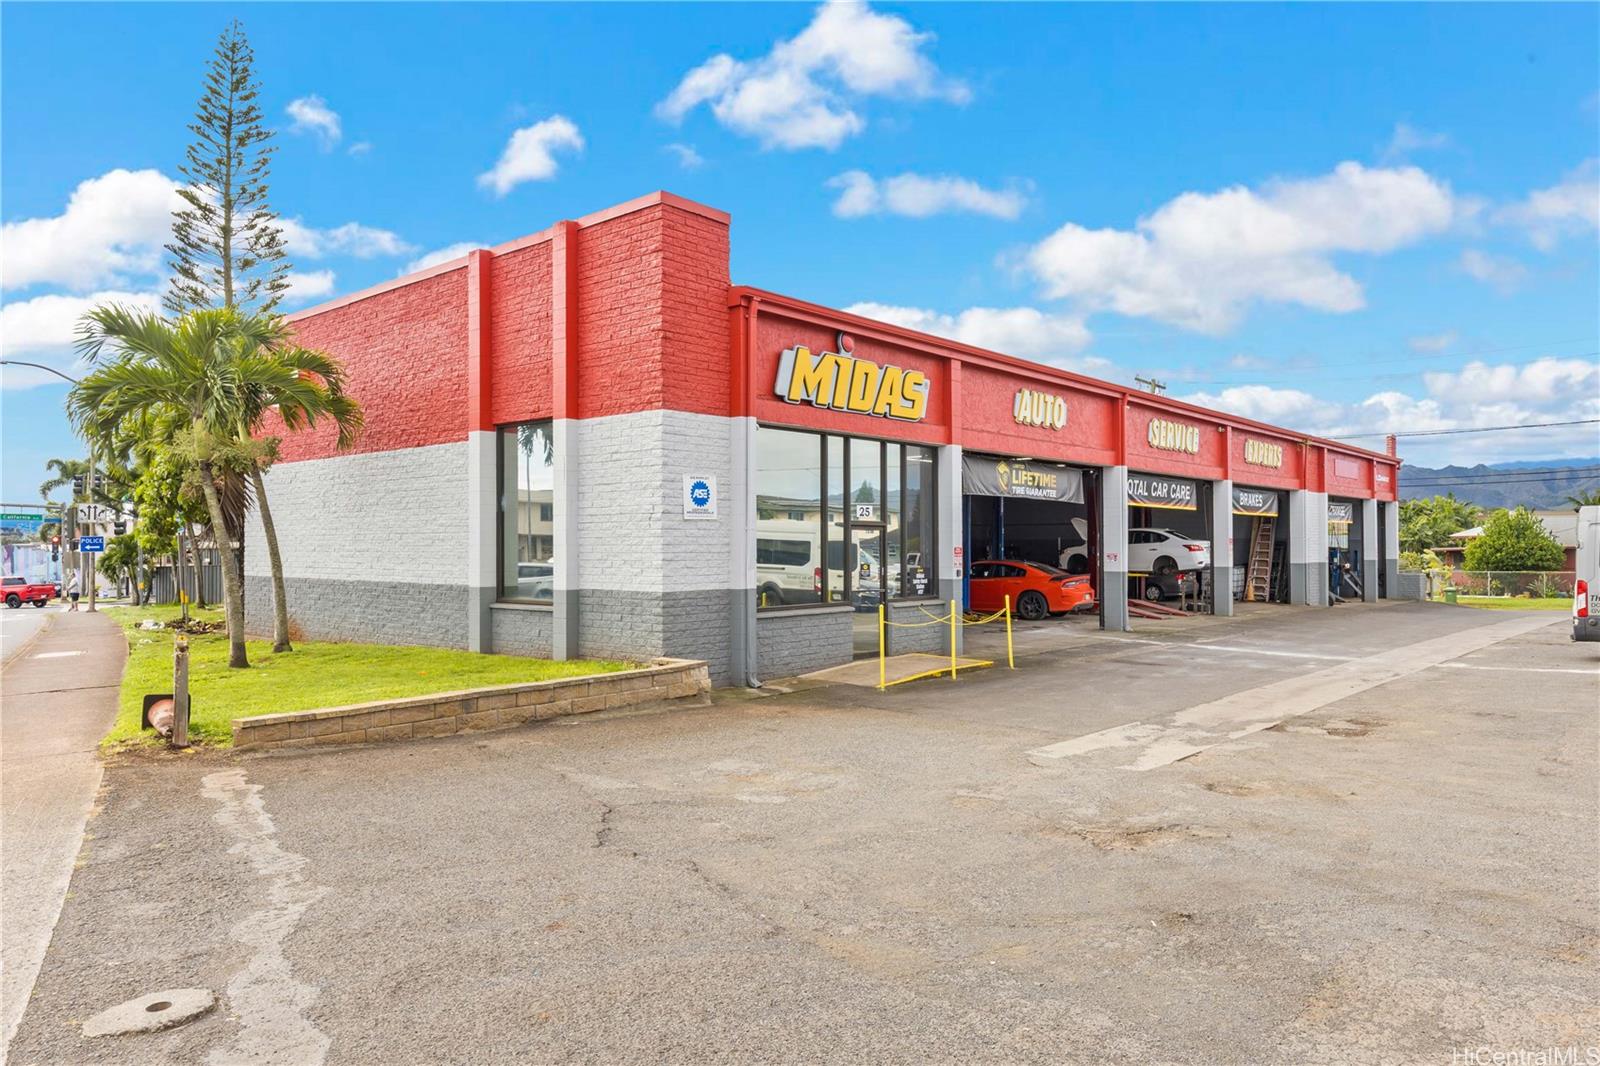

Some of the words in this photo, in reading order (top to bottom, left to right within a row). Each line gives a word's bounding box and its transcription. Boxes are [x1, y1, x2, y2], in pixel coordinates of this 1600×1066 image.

[785, 334, 927, 421] MIDAS
[1016, 388, 1066, 430] AUTO
[1149, 418, 1200, 454] SERVICE
[1012, 470, 1057, 488] LIFETIME
[1012, 486, 1025, 495] TIRE
[1128, 479, 1148, 496] OTAL
[1151, 482, 1168, 498] CAR
[1170, 485, 1191, 500] CARE
[1239, 492, 1264, 507] BRAKES
[859, 506, 871, 517] 25
